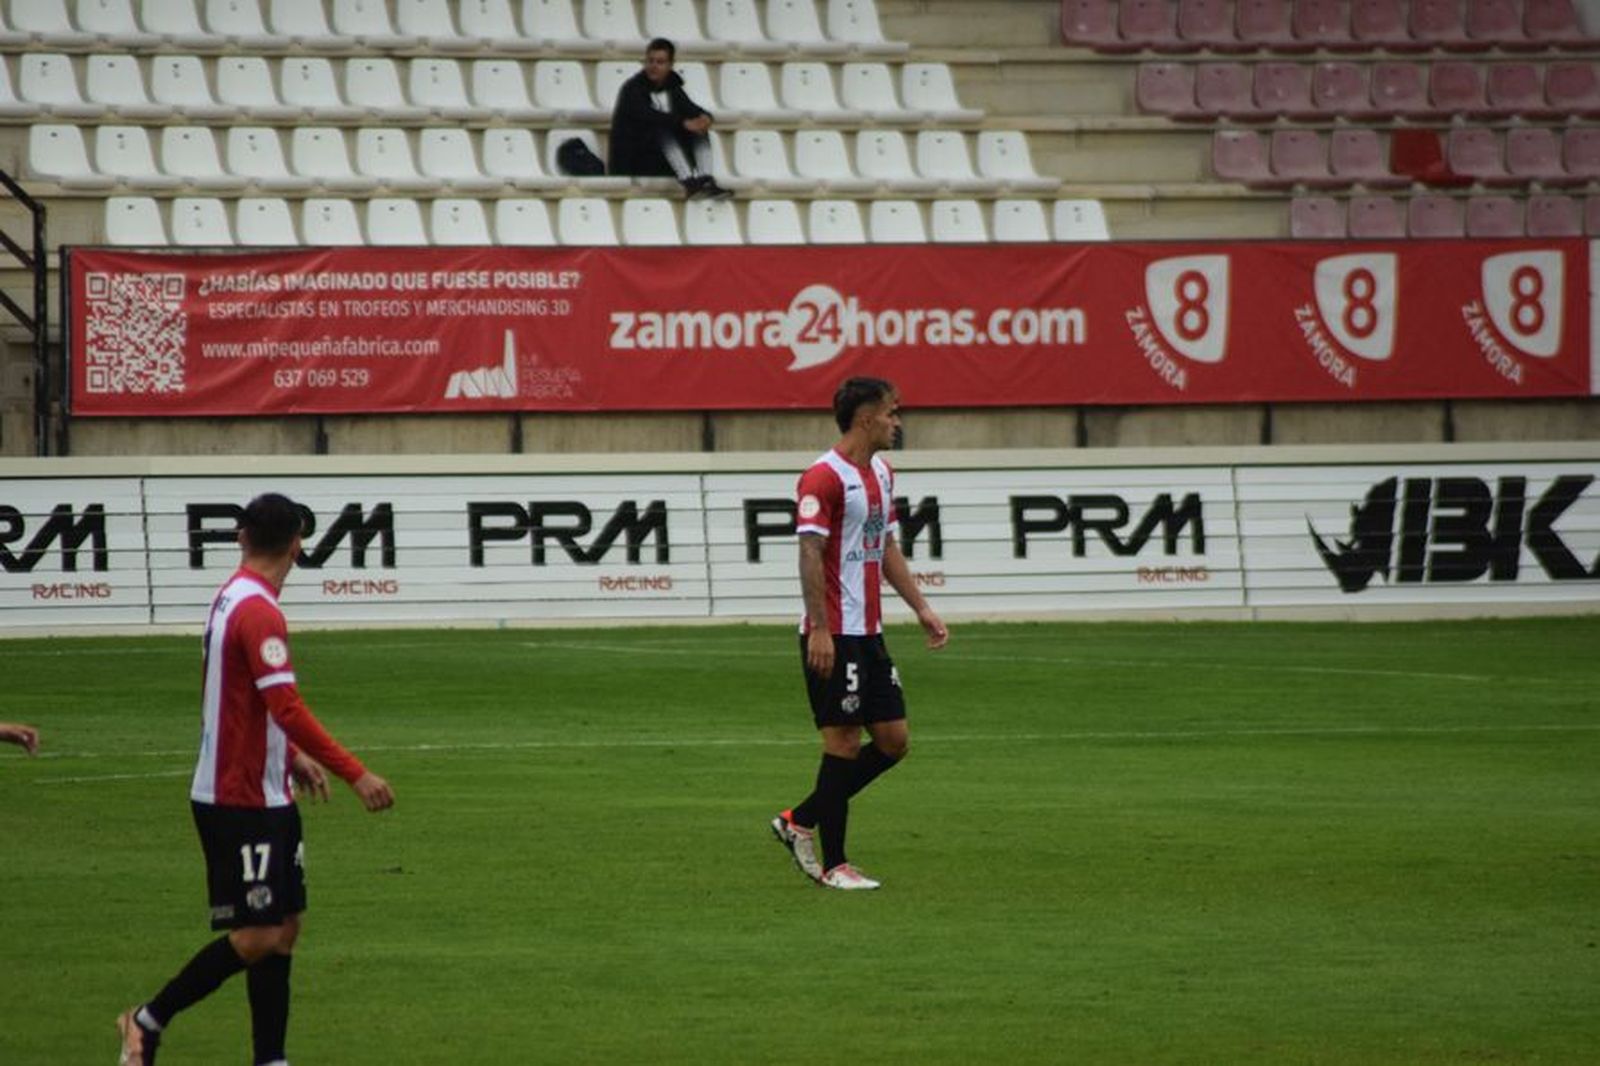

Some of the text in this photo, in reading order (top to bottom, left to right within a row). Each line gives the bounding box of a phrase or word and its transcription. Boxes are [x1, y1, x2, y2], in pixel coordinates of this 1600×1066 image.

[199, 271, 579, 295] ¿HABÍAS IMAGINADO QUE FUESE POSIBLE?
[208, 299, 570, 318] ESPECIALISTAS EN TROFEOS Y MERCHANDISING 3D
[1173, 269, 1210, 341] 8
[1342, 267, 1378, 339] 8
[1508, 265, 1546, 337] 8
[201, 336, 440, 360] www.mipequeñafabrica.com
[1125, 306, 1187, 391] ZAMORA
[1294, 303, 1358, 388] ZAMORA
[1461, 299, 1524, 385] ZAMORA
[273, 368, 369, 388] 637 069 529
[467, 499, 669, 567] PRM
[1009, 492, 1206, 558] PRM
[31, 583, 112, 600] RACING
[323, 579, 399, 596] RACING
[599, 575, 673, 592] RACING
[1136, 566, 1210, 584] RACING
[846, 662, 859, 692] 5
[240, 844, 271, 881] 17
